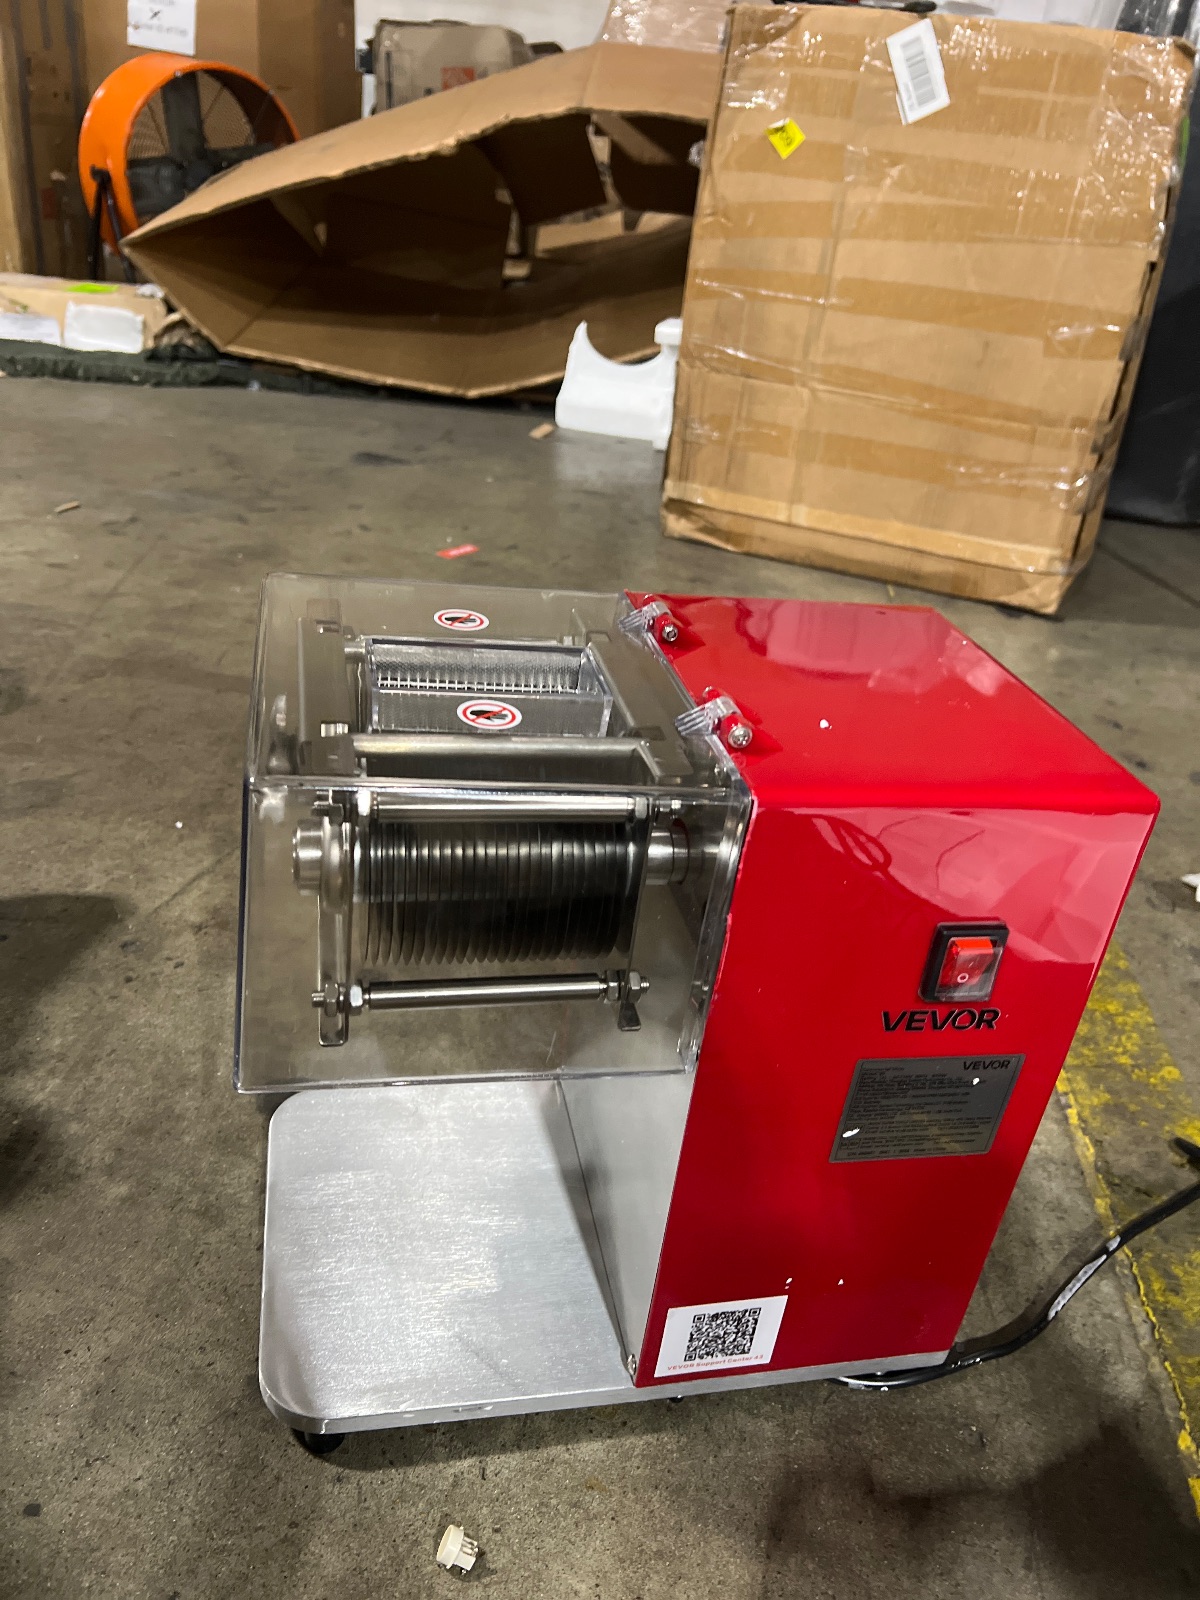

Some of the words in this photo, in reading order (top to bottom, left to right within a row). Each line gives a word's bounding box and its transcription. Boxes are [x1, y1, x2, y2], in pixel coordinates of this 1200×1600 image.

[881, 1007, 1001, 1032] VEVOR
[963, 1059, 1011, 1071] VEVOR
[667, 1363, 695, 1371] VEVOR
[696, 1359, 726, 1367] Support
